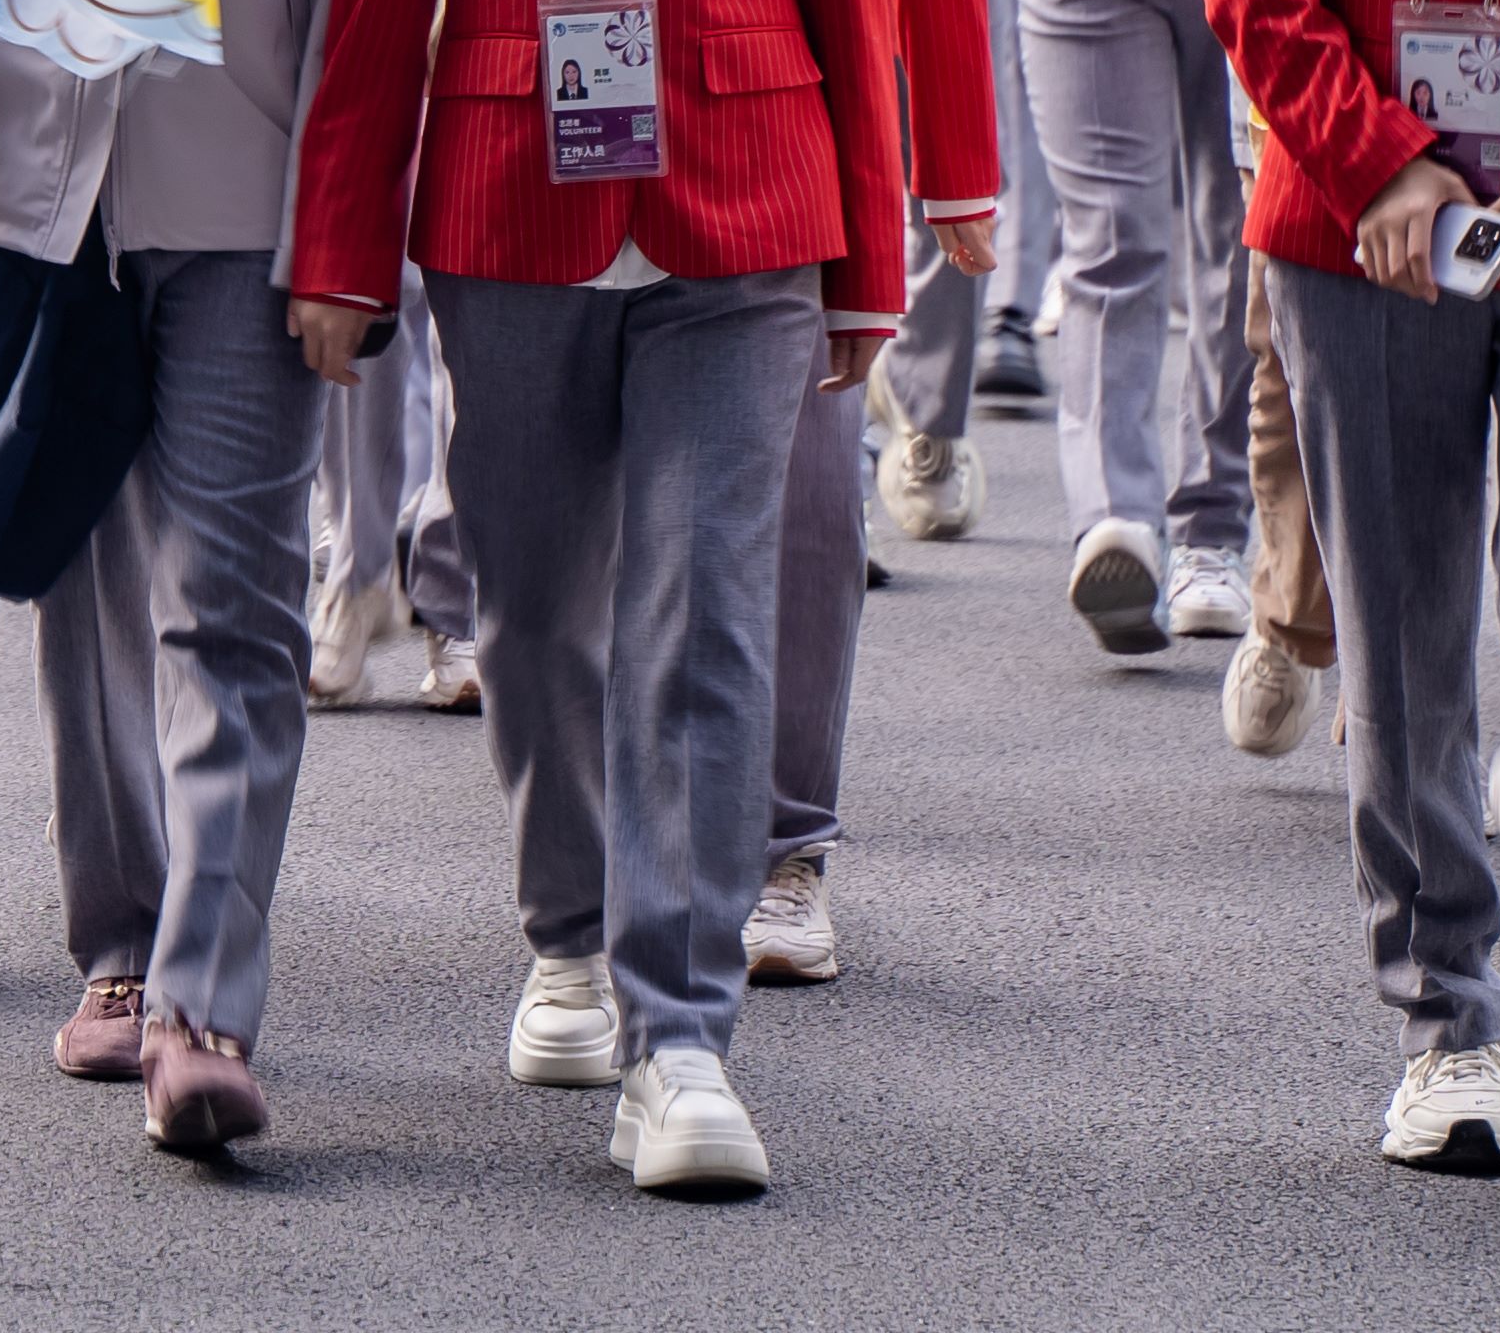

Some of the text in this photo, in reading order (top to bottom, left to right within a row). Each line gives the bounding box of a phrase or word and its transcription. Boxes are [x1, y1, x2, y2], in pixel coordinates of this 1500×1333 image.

[559, 126, 603, 136] VOLUNTEER
[560, 144, 606, 159] 工作人员
